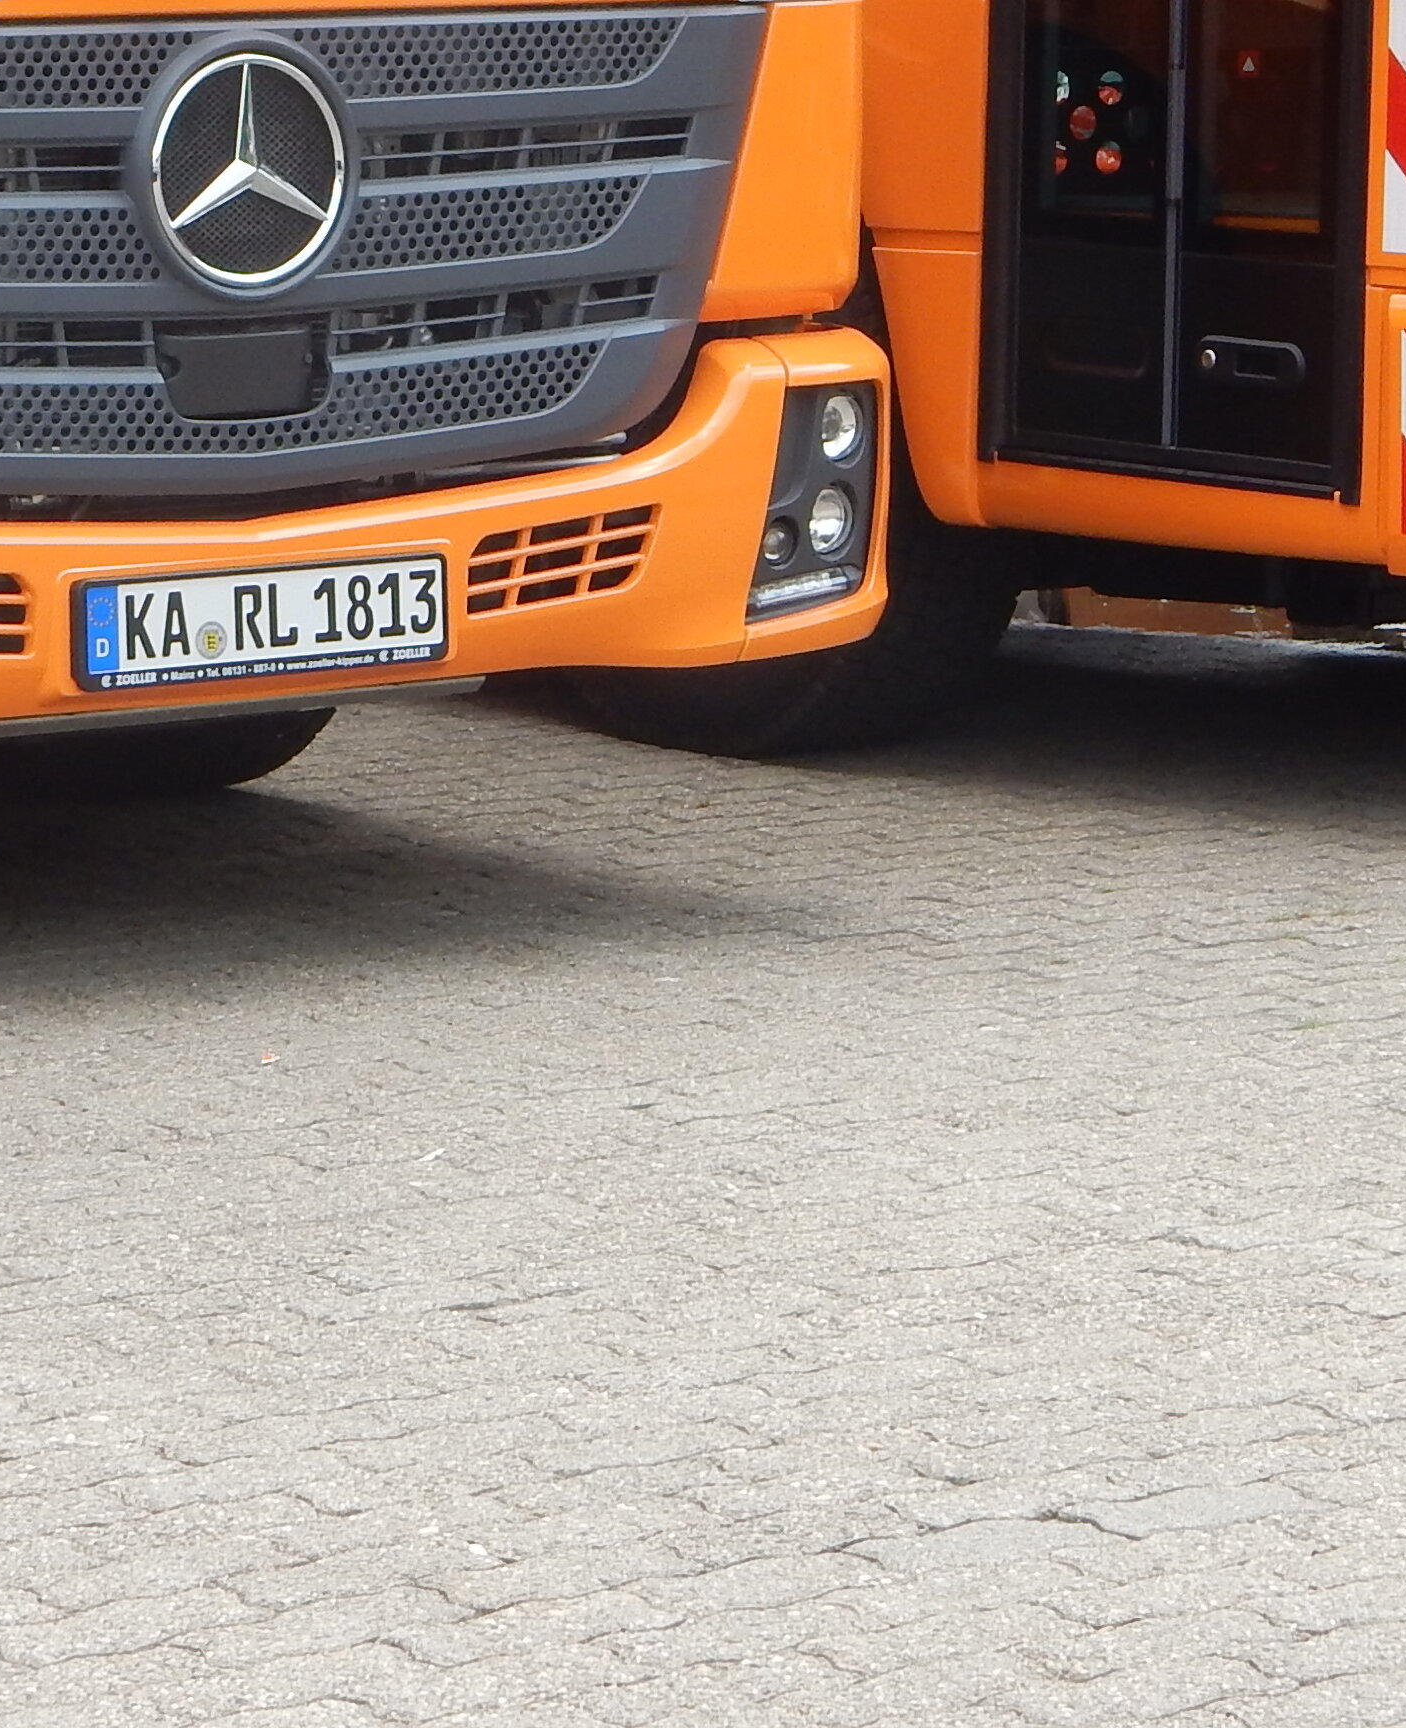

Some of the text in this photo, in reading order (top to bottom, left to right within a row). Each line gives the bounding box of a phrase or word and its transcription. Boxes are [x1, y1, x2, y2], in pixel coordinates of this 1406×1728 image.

[125, 569, 437, 661] KA RL 1813
[95, 637, 110, 658] D
[115, 672, 158, 686] ZOELLER
[391, 646, 431, 660] ZOELLER
